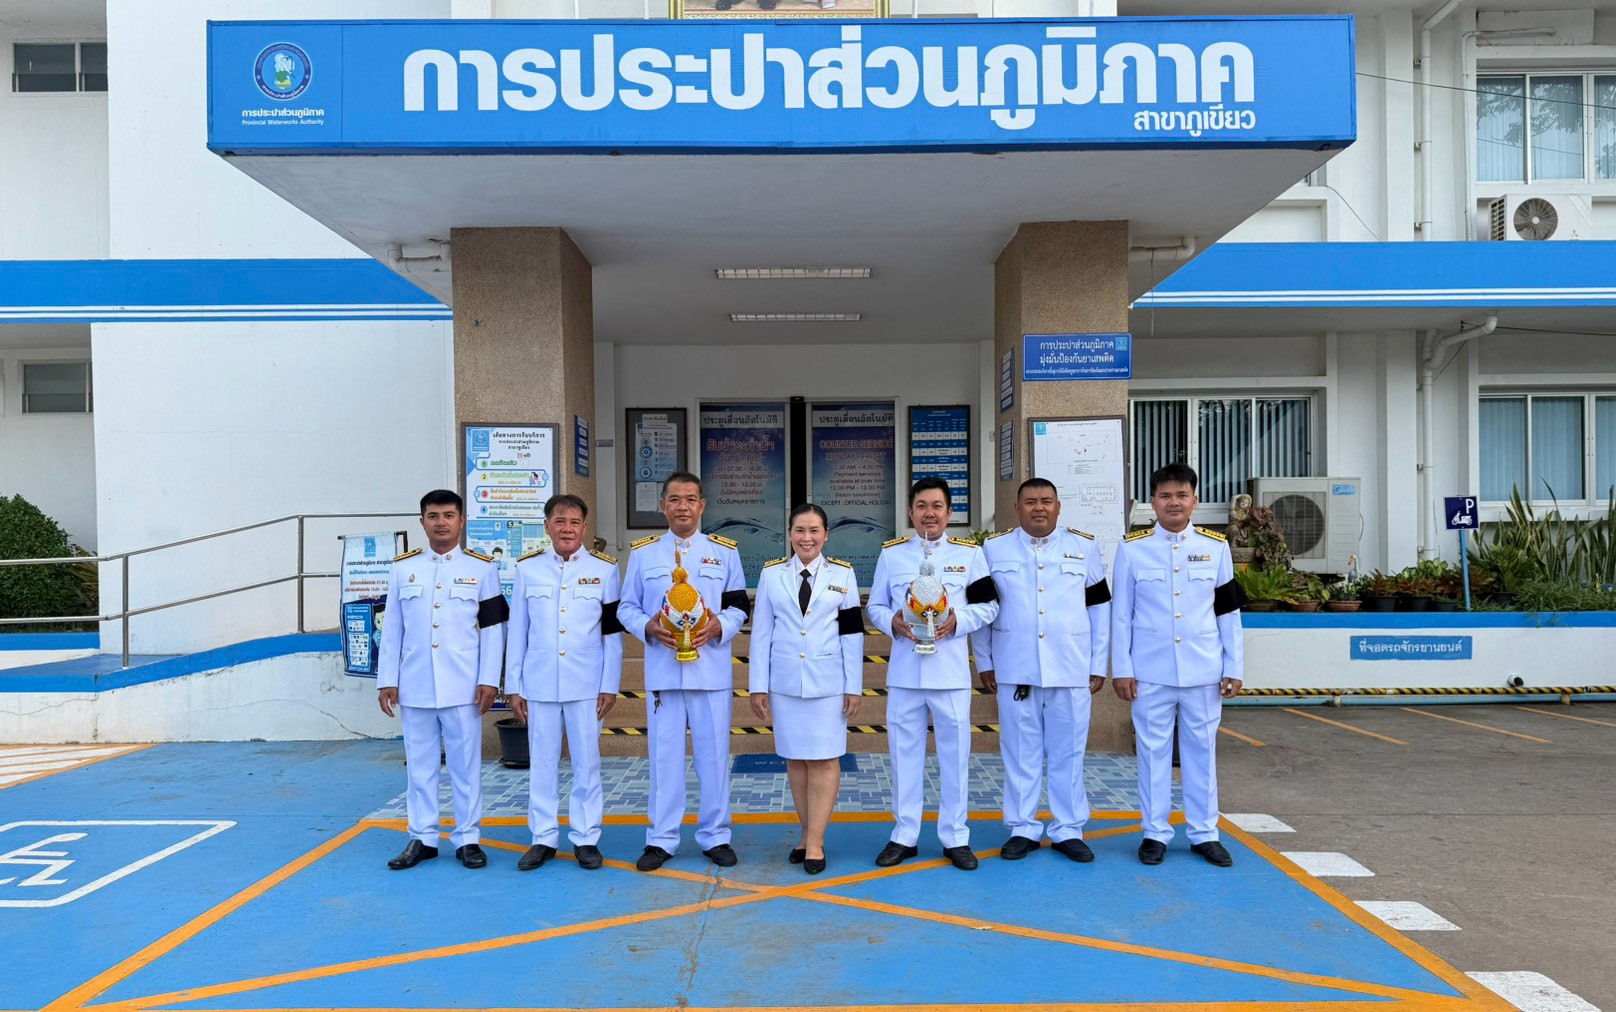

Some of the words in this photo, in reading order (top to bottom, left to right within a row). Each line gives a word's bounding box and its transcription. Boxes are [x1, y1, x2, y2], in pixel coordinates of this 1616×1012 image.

[403, 25, 1256, 130] การประปาส่วนภูมิภาค
[242, 108, 324, 118] การประปาส่วนภูมิภาค
[1134, 105, 1256, 137] สาขาภูเขียว
[1040, 338, 1115, 353] การประปาส่วนภูมิภาค
[1040, 351, 1115, 367] มุ่งมั่นป้องกันยาเสพติด
[703, 412, 778, 427] ประตูเลื่อนอัตโนมัติ
[706, 434, 775, 451] รับชำระค่าน้ำ
[819, 439, 858, 449] COUNTER
[859, 439, 893, 449] SERVICE
[825, 451, 856, 460] MONDAY
[862, 451, 887, 460] FRIDAY
[1465, 498, 1475, 514] P
[1359, 638, 1463, 652] ที่จอดรถจักรยานยนต์
